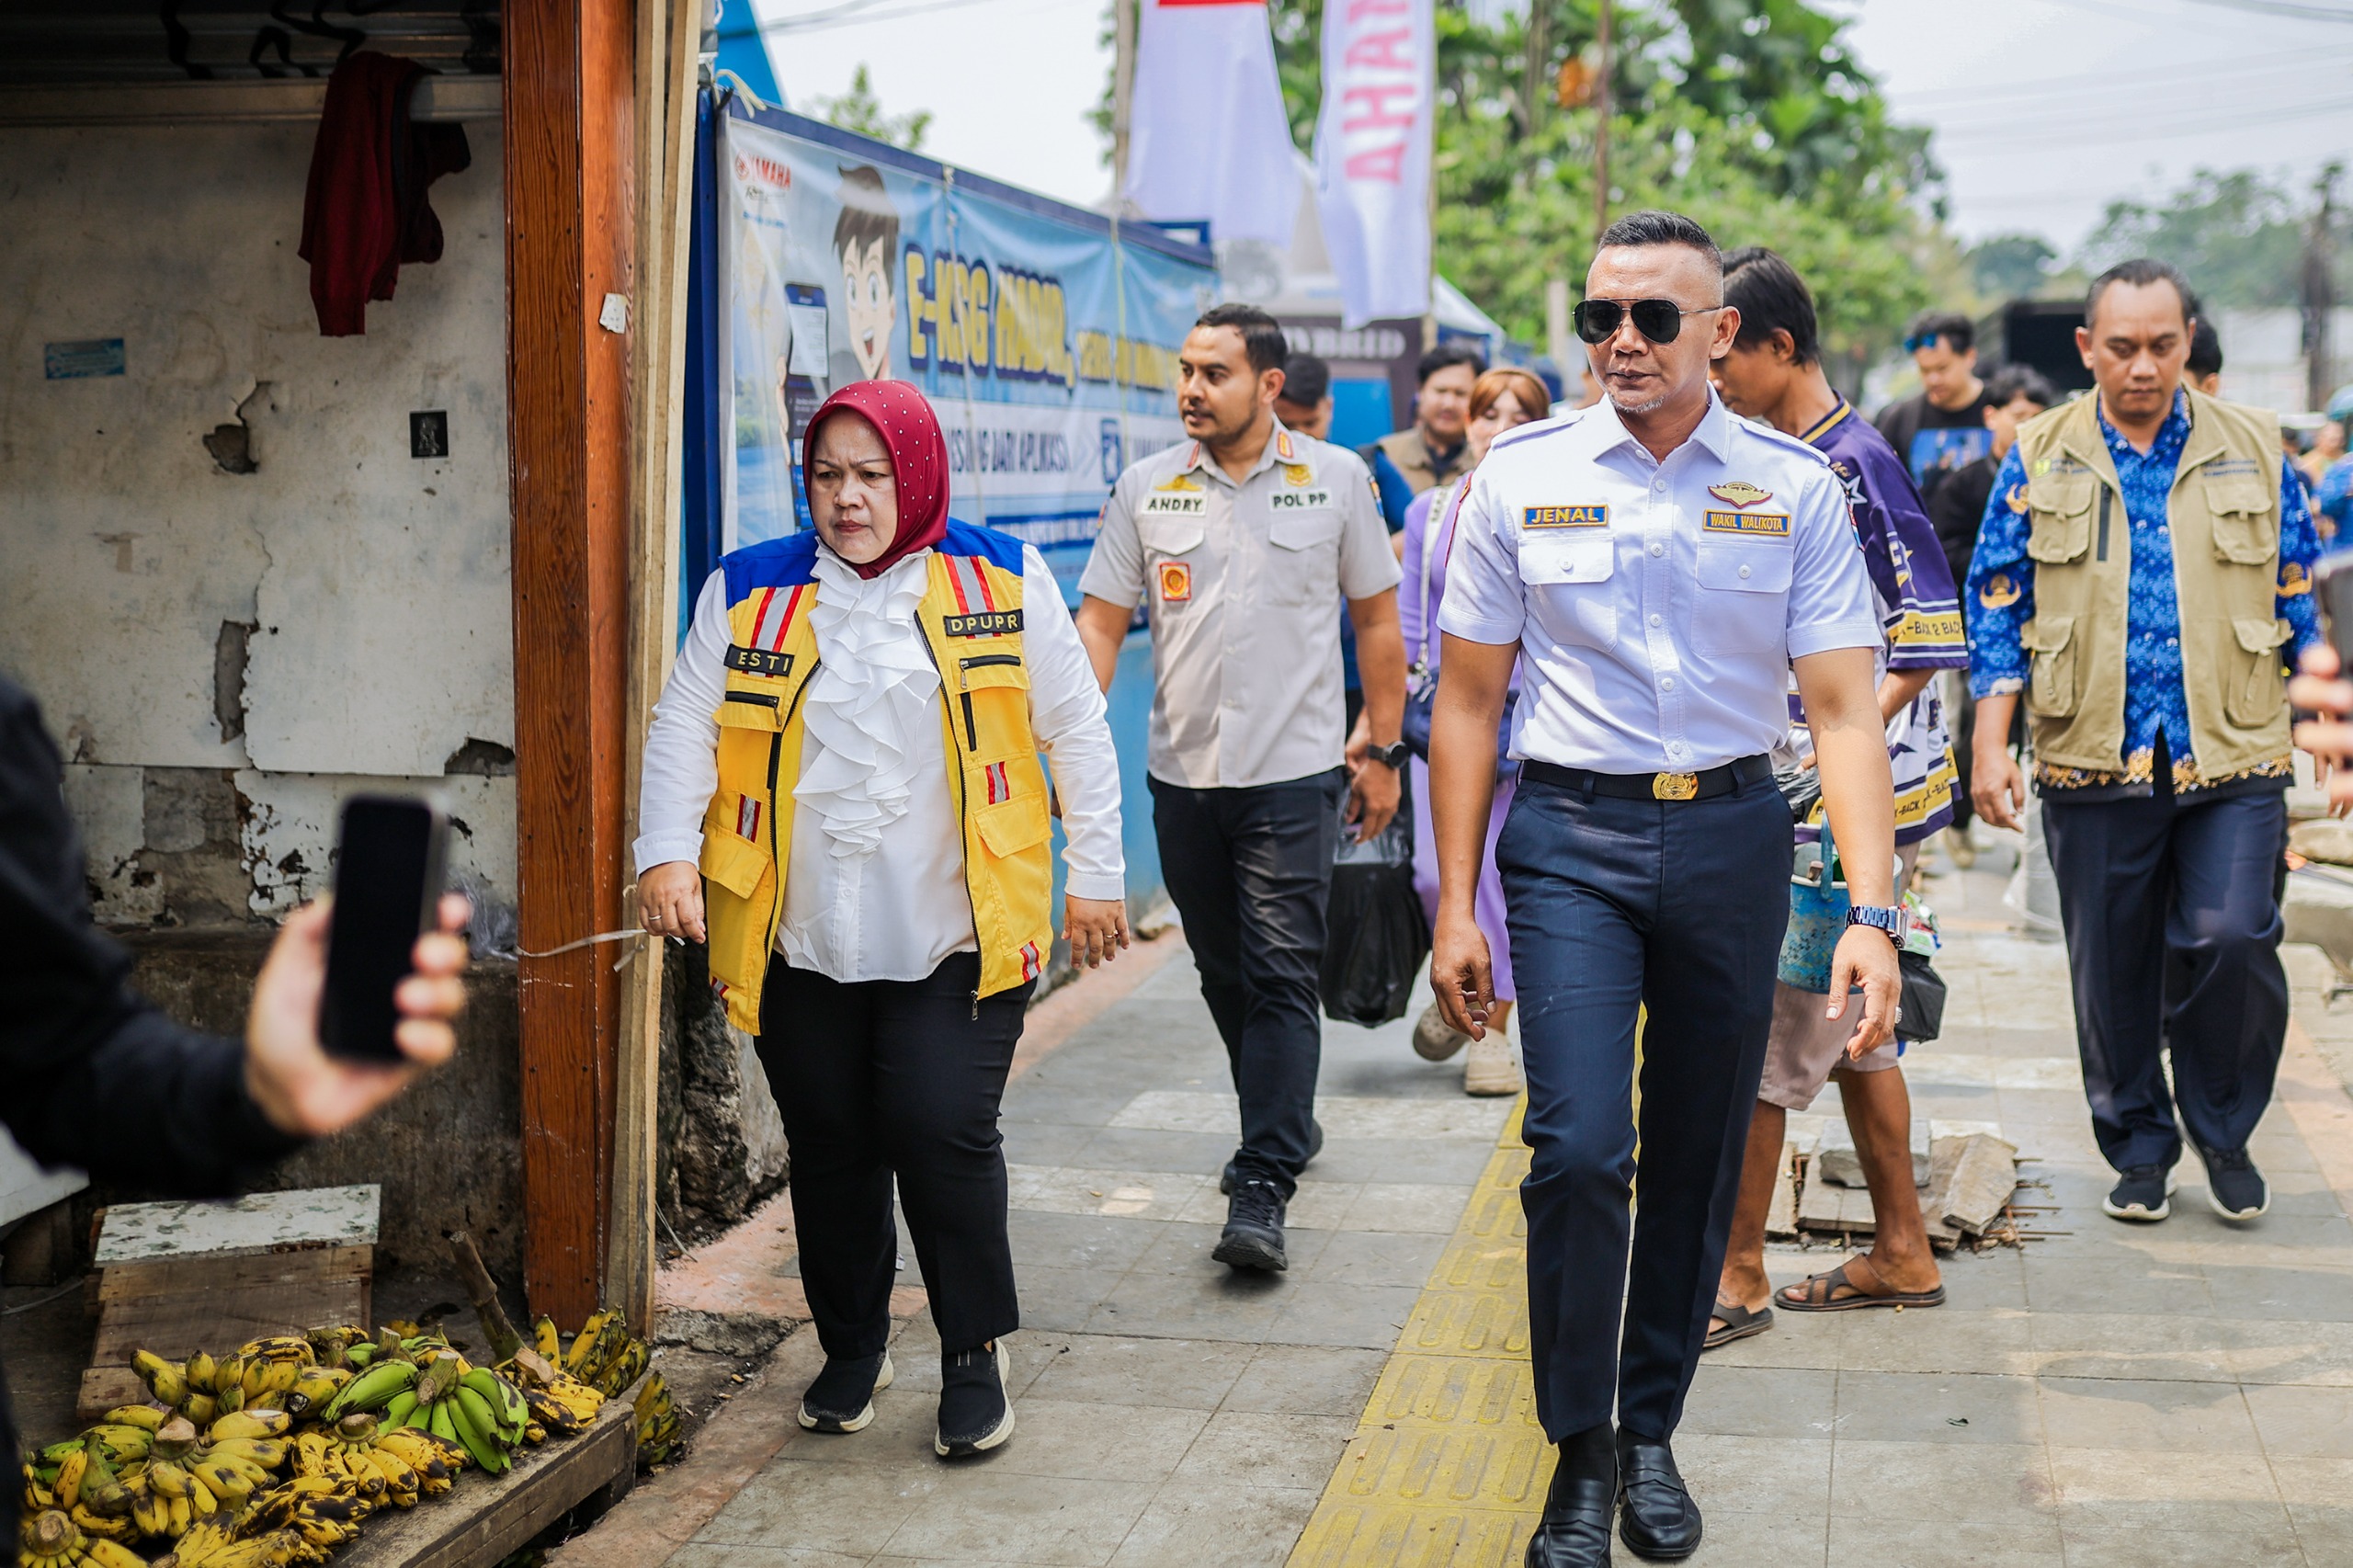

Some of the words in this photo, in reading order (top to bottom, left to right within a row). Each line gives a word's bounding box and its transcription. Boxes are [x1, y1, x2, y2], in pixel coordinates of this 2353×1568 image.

[1148, 497, 1203, 513] ANDRY
[1273, 494, 1303, 508] POL
[1309, 492, 1327, 505] PP
[1529, 507, 1599, 525] JENAL
[1711, 512, 1738, 528] WAKIL
[1741, 515, 1783, 532] WALIKOTA
[949, 612, 1018, 632] DPUPR
[736, 651, 790, 673] ESTI
